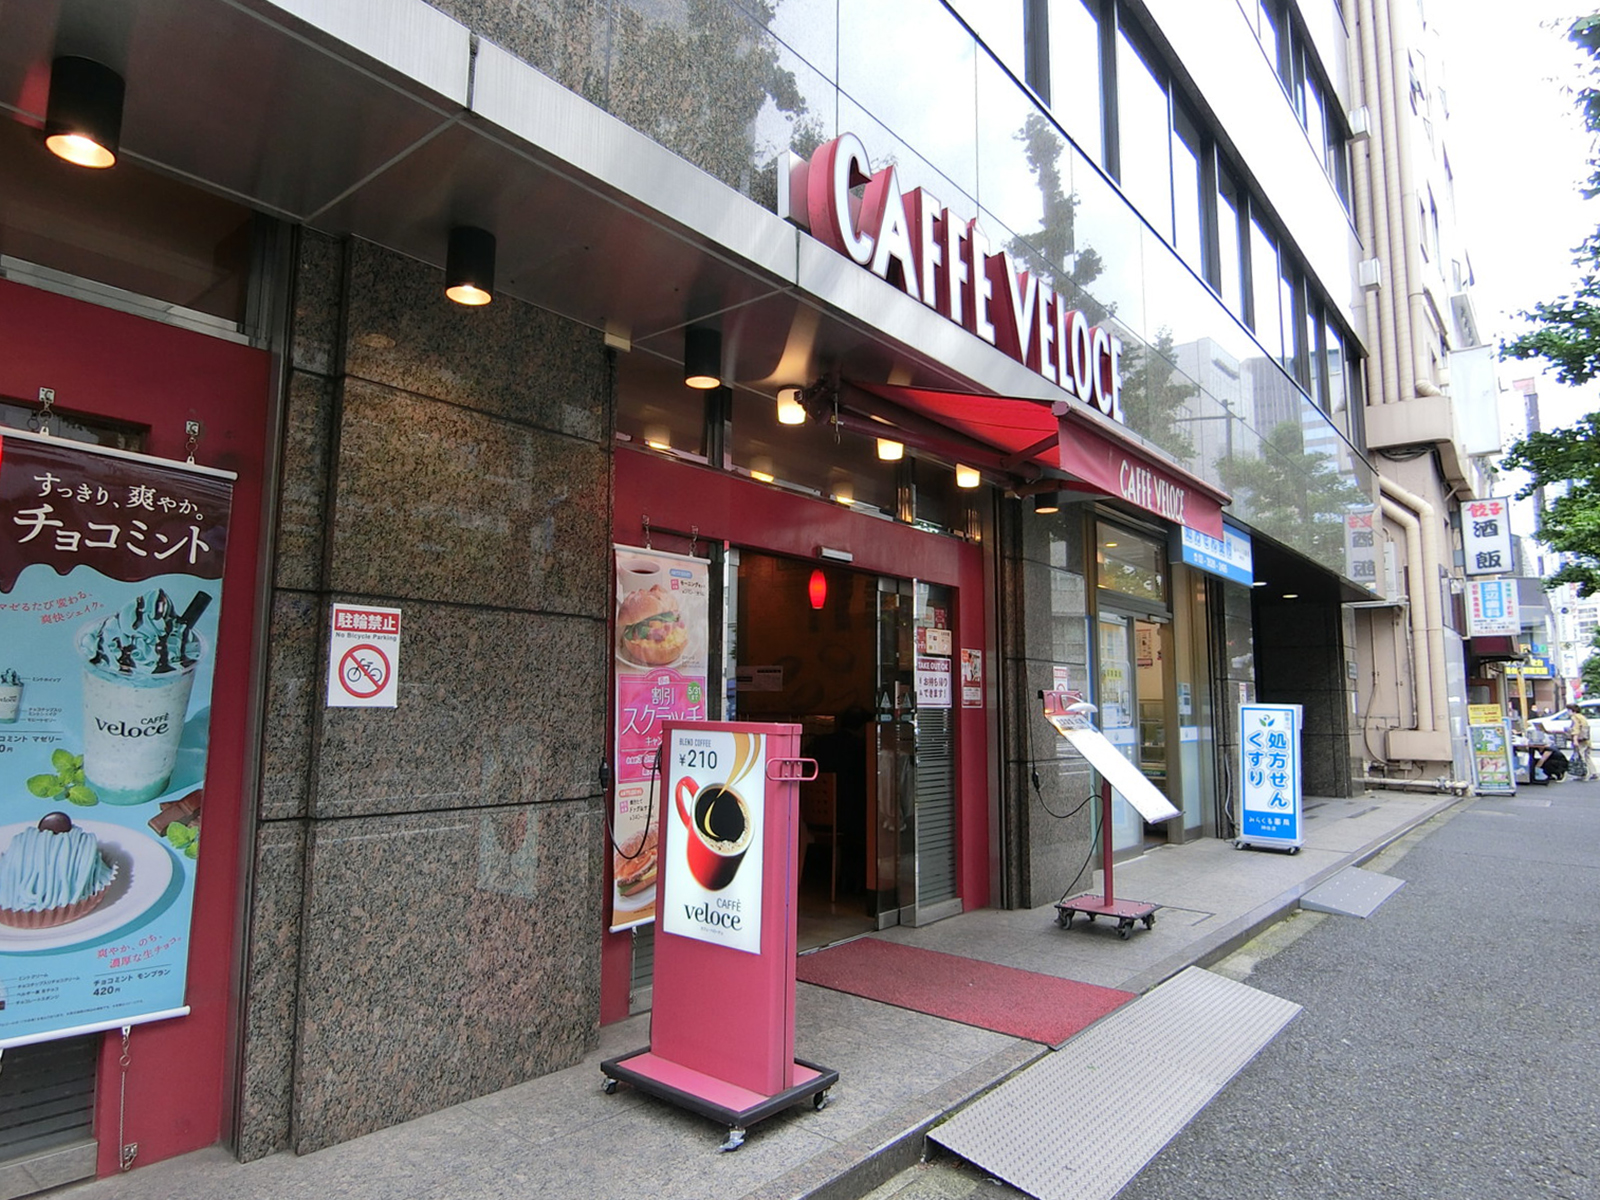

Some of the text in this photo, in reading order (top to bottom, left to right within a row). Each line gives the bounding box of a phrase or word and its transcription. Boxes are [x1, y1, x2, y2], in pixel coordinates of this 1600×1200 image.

[1002, 251, 1125, 426] VELOCE
[34, 472, 204, 521] すっきり、爽やか。
[1153, 475, 1186, 525] VELOCE
[1466, 502, 1503, 517] 餃子
[13, 504, 210, 564] チョコミント
[1473, 519, 1502, 569] 酒 飯
[337, 612, 397, 631] 駐輪禁止
[347, 632, 371, 640] Bicycle
[373, 634, 397, 642] Parking
[918, 661, 949, 671] TAKE OUT OK
[651, 686, 675, 705] 割引
[687, 686, 702, 695] 5/31
[679, 737, 712, 748] BLEND COFFEE
[679, 749, 718, 770] ¥210
[1247, 732, 1265, 786] くすり
[1267, 732, 1288, 808] 処方せん
[684, 902, 743, 931] veloce
[93, 969, 171, 987] チョコミント モンブラン
[93, 985, 121, 996] 420円
